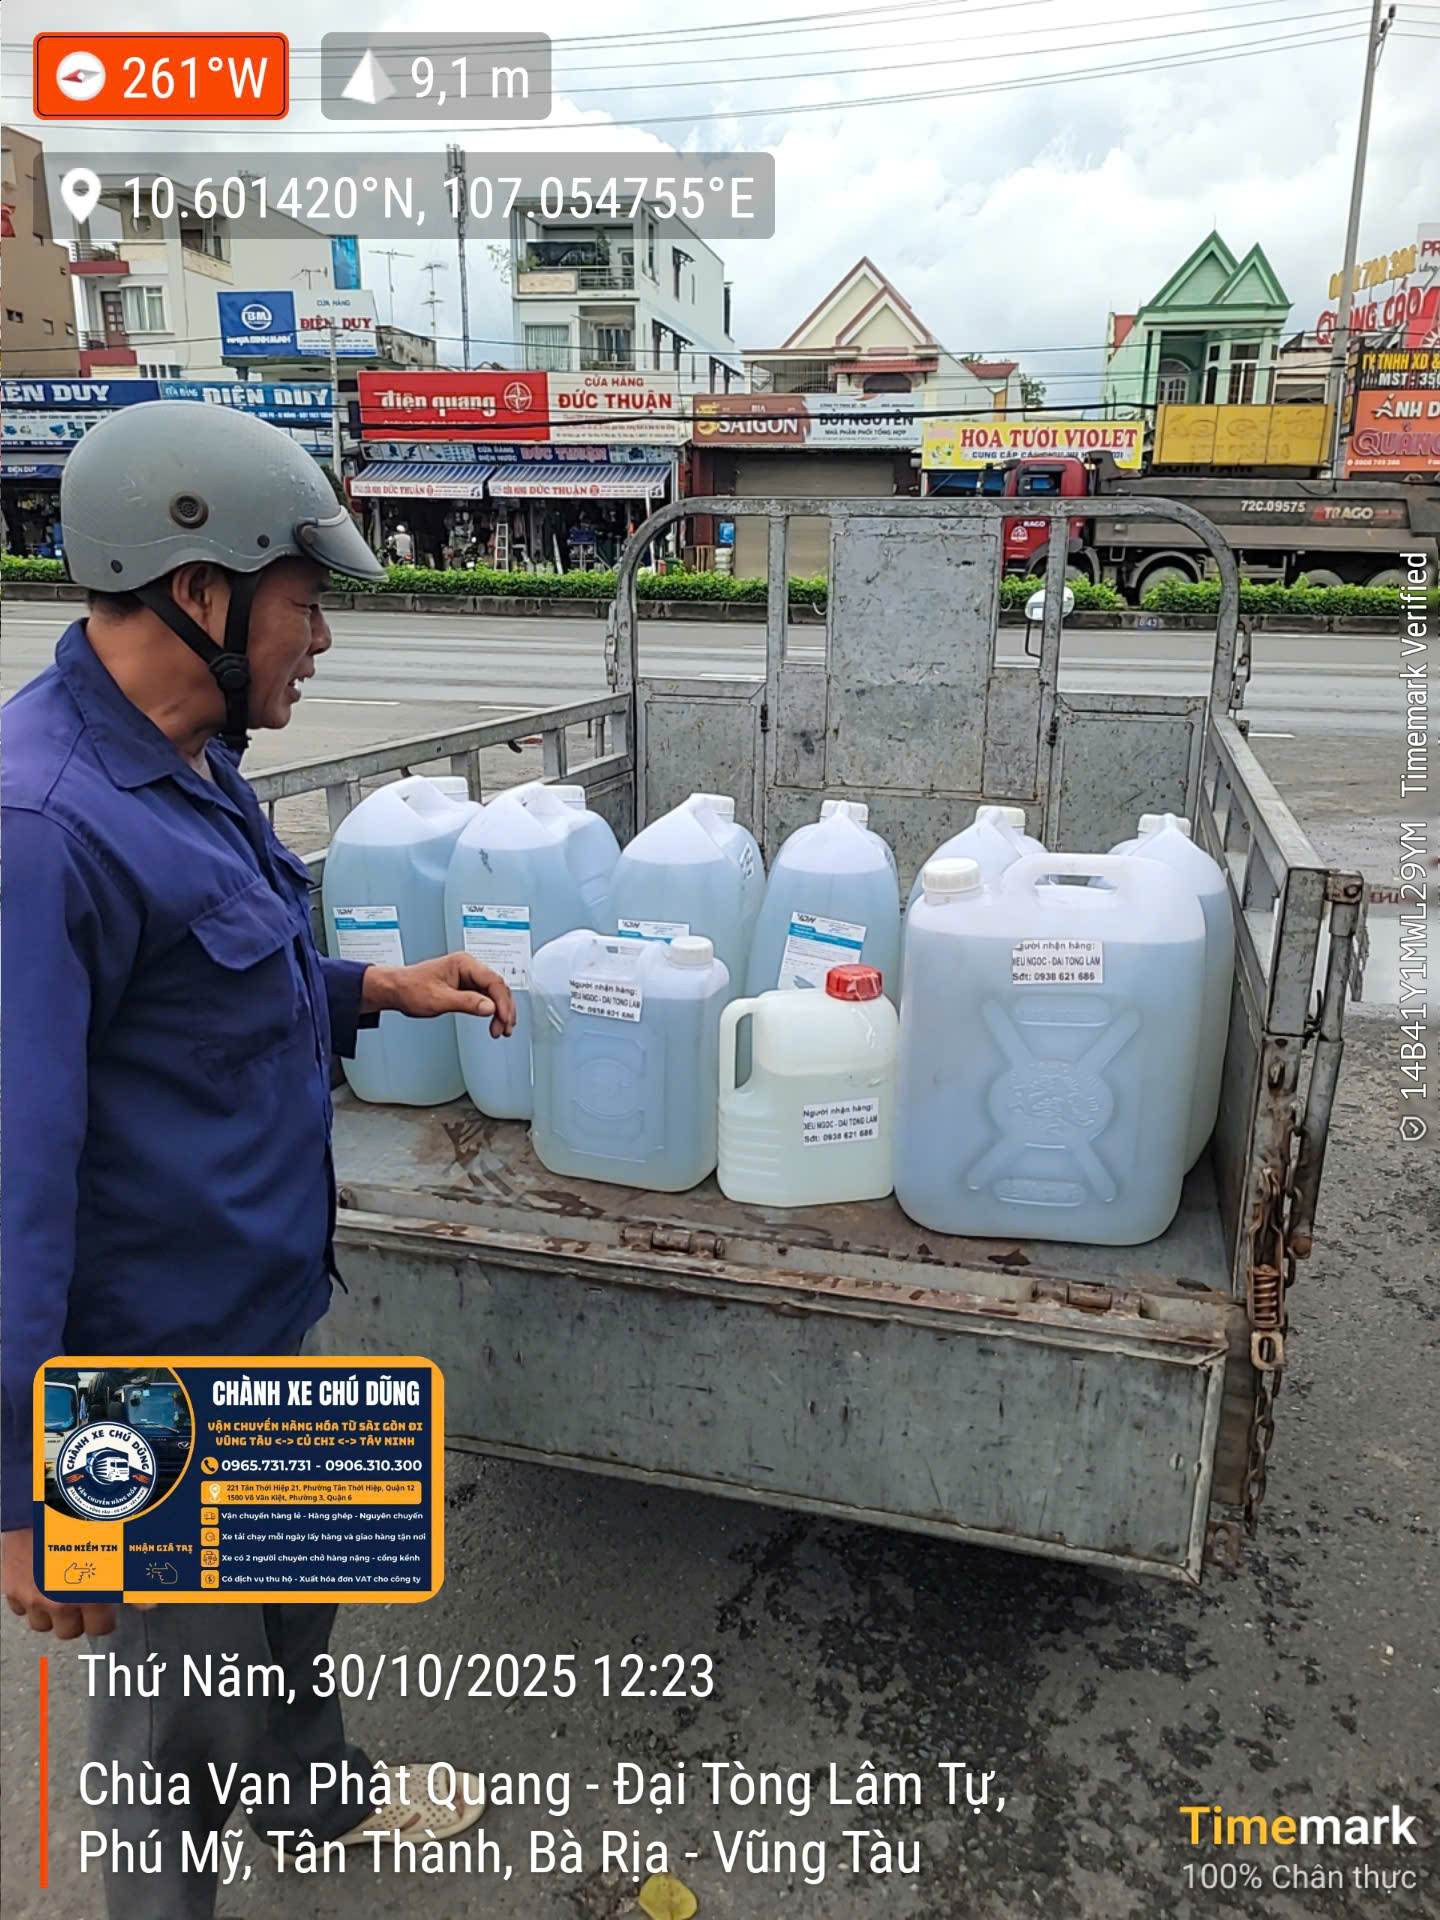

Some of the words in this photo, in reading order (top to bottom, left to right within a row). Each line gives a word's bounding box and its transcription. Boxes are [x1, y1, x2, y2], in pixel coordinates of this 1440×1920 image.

[341, 317, 371, 329] DUY
[585, 374, 608, 387] CỬA
[611, 373, 644, 387] HÀNG
[1, 381, 45, 404] ỆN
[51, 384, 110, 402] DUY
[273, 388, 328, 405] DUY
[373, 389, 427, 413] điện
[432, 395, 497, 417] quang
[558, 388, 598, 408] ĐỨC
[604, 390, 672, 415] THUẬN
[961, 429, 1003, 448] HOA
[1009, 426, 1059, 448] TƯƠI
[1064, 428, 1138, 448] VIOLET
[1241, 500, 1306, 513] 72C.09575
[1324, 506, 1374, 520] TRAGO
[1020, 941, 1041, 951] gười
